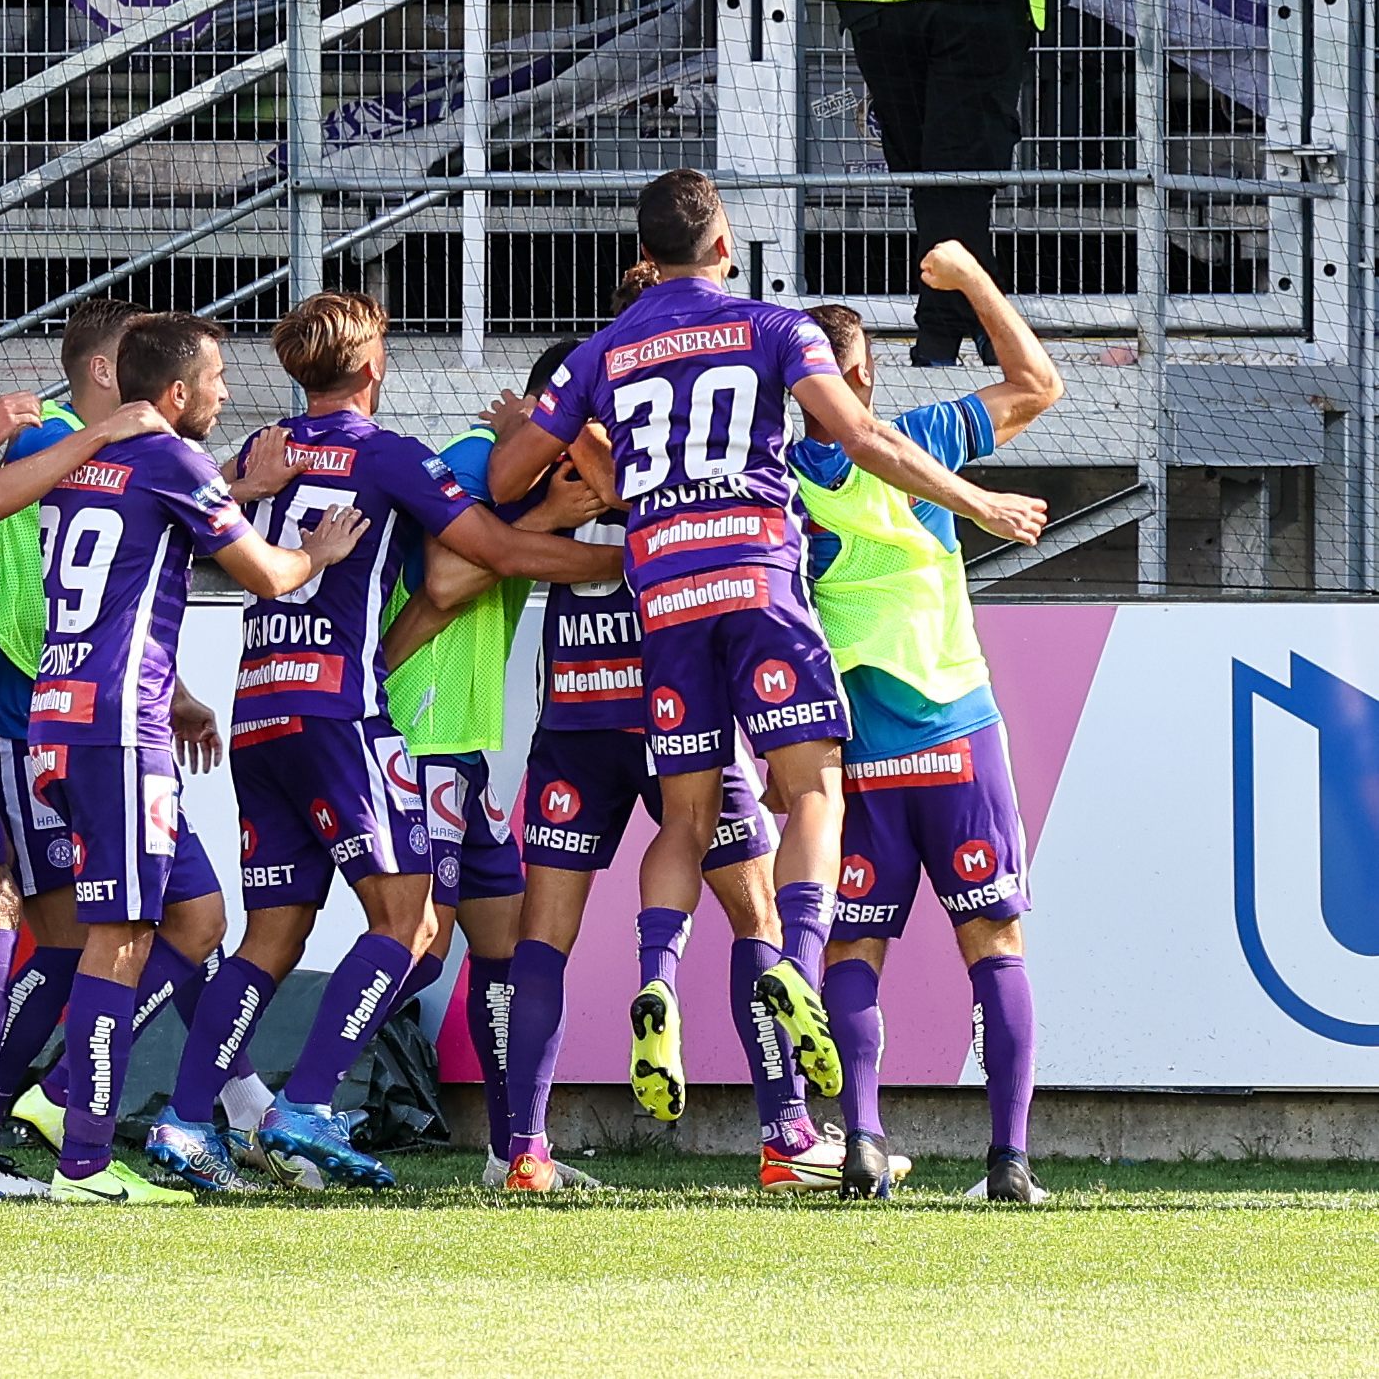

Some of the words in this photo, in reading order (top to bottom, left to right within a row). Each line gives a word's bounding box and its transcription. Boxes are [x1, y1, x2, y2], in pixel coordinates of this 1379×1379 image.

[638, 326, 746, 362] GENERALI
[613, 365, 758, 500] 30
[638, 472, 750, 517] FISCHER
[747, 699, 839, 736] MARSBET
[834, 902, 900, 924] RSBET
